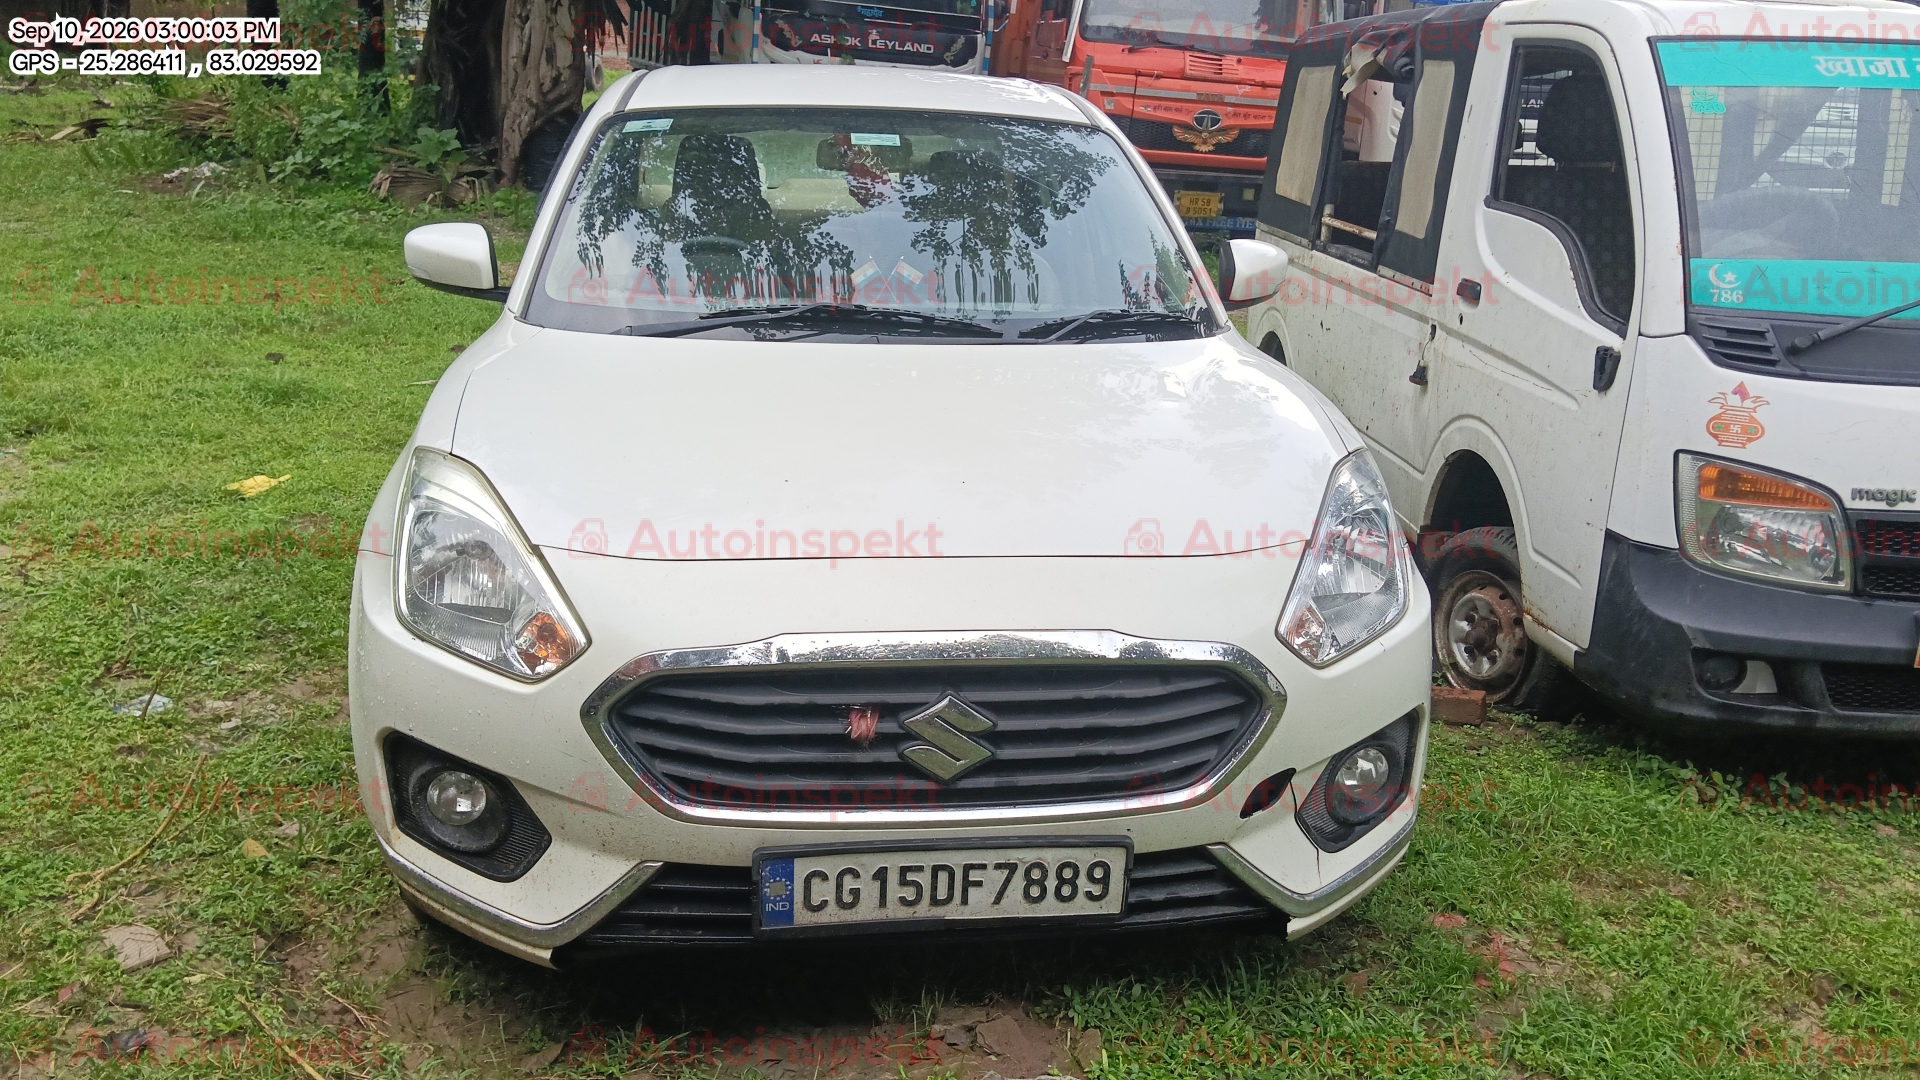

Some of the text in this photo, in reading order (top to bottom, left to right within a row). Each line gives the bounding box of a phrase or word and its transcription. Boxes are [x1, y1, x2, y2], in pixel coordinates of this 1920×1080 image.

[868, 39, 934, 54] LEYLAND
[1710, 289, 1744, 304] 786
[1851, 488, 1917, 508] magic
[765, 858, 1112, 913] IND CG15DF7889
